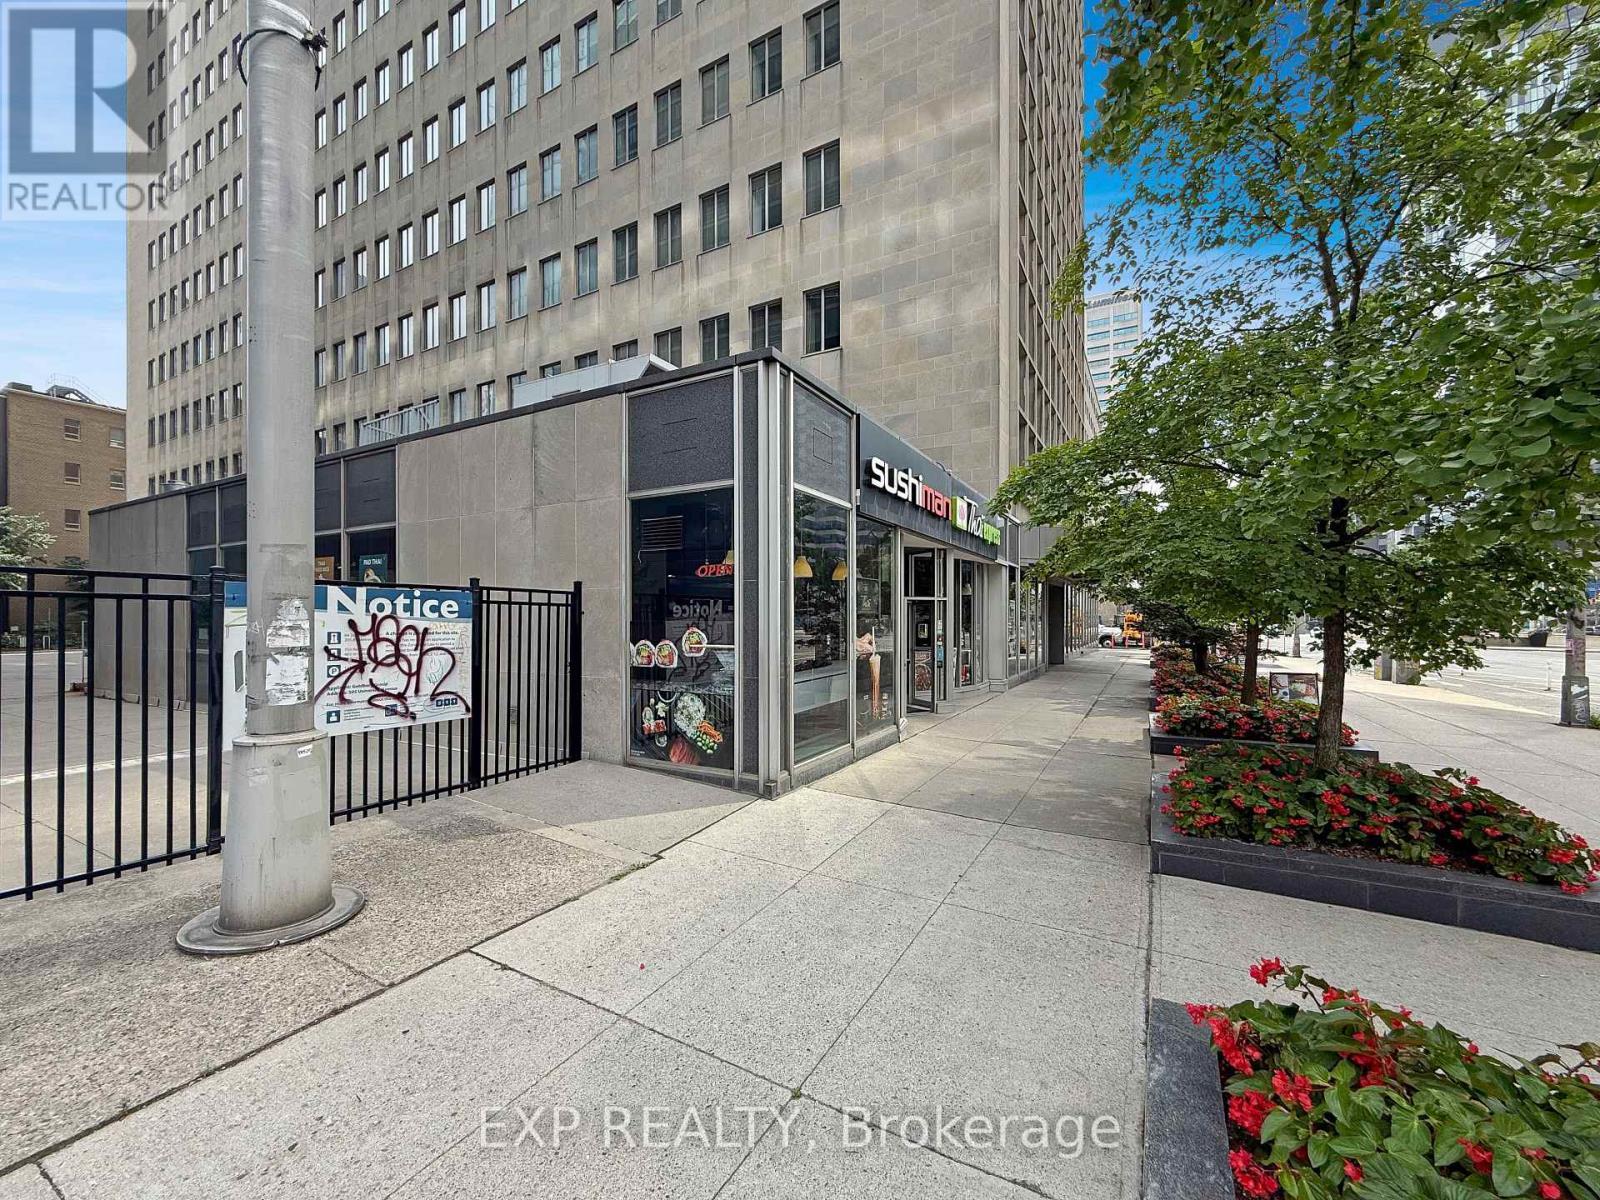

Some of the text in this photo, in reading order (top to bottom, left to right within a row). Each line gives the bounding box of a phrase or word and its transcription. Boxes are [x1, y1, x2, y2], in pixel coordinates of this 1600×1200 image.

[871, 457, 952, 520] sushiman
[697, 565, 733, 577] OPEN
[327, 586, 459, 619] Notice
